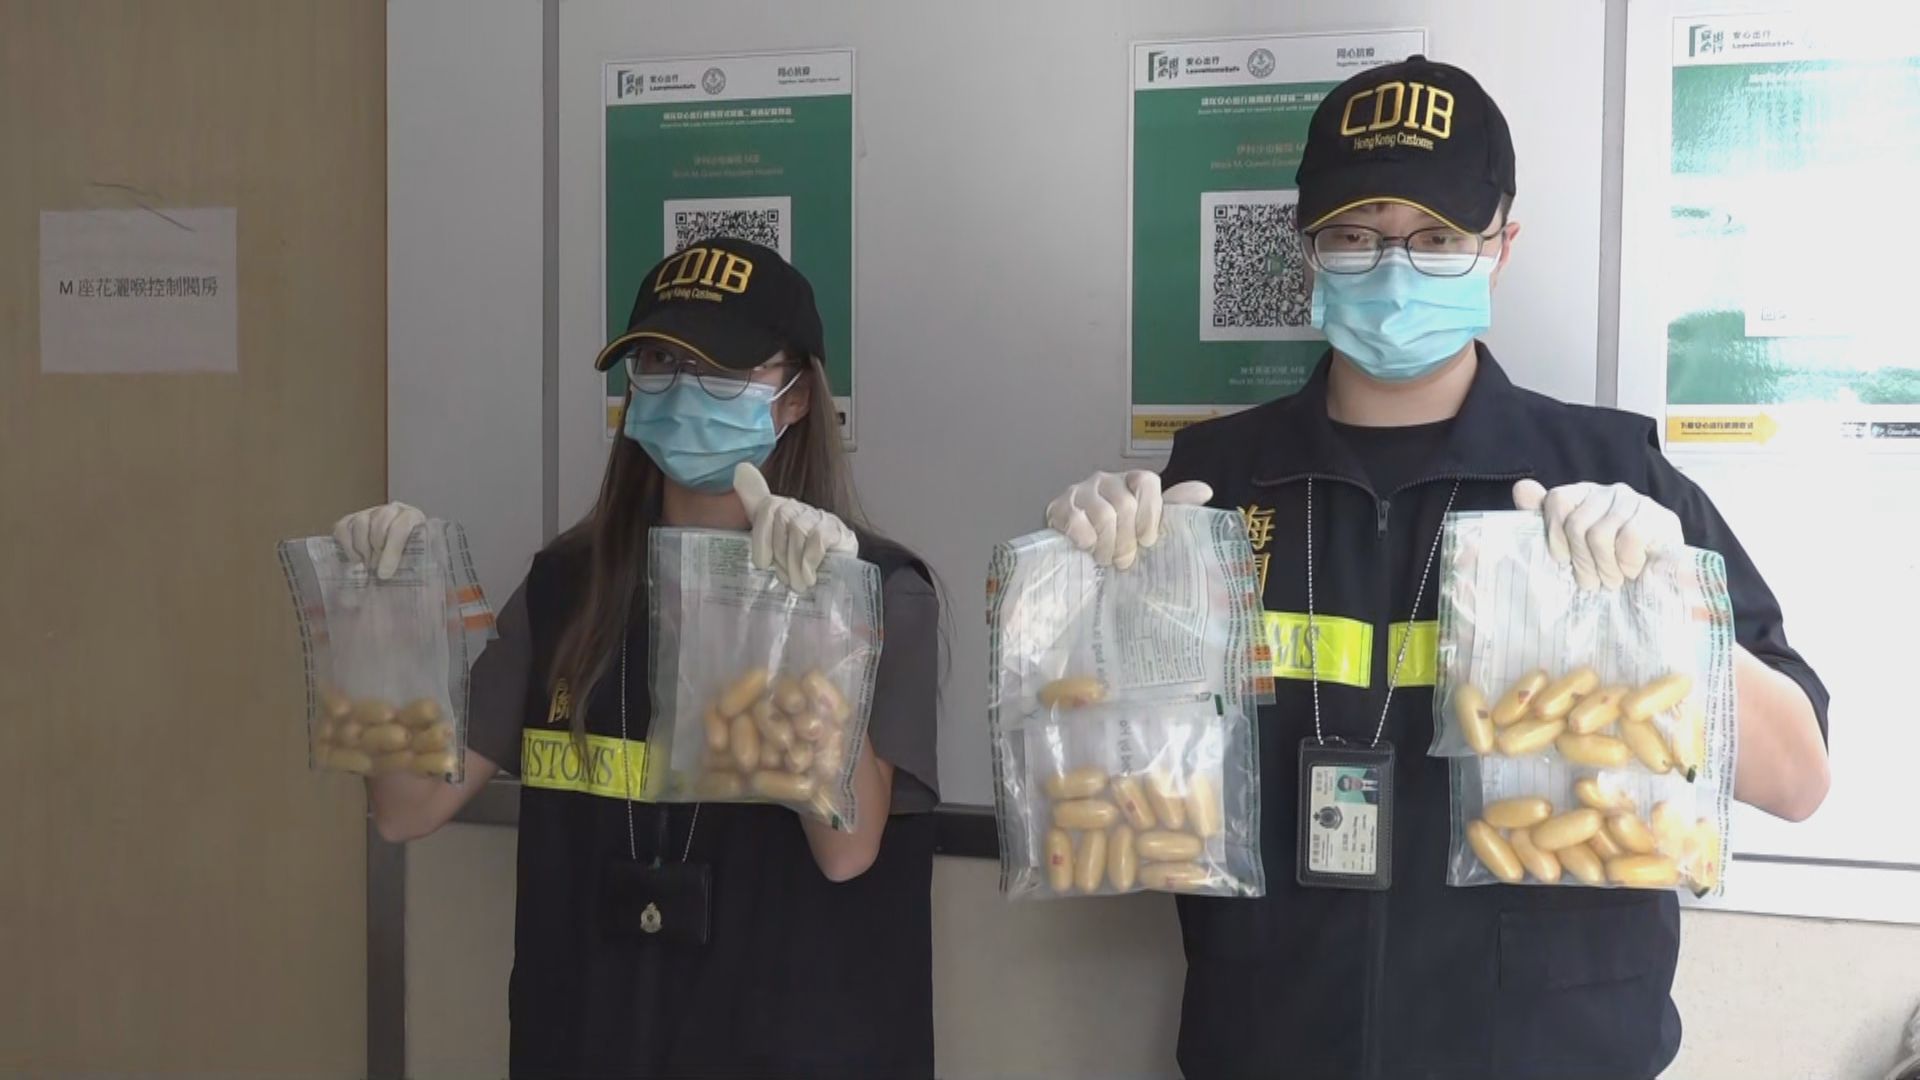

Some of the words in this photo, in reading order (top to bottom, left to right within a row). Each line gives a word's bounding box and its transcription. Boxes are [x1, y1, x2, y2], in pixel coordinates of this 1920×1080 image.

[1340, 80, 1455, 140] CDIB
[1353, 135, 1375, 151] Hong
[1375, 132, 1397, 148] Kong
[1397, 131, 1435, 152] Customs
[58, 280, 74, 295] M
[653, 247, 754, 294] CDIB
[521, 737, 615, 786] USTOMS
